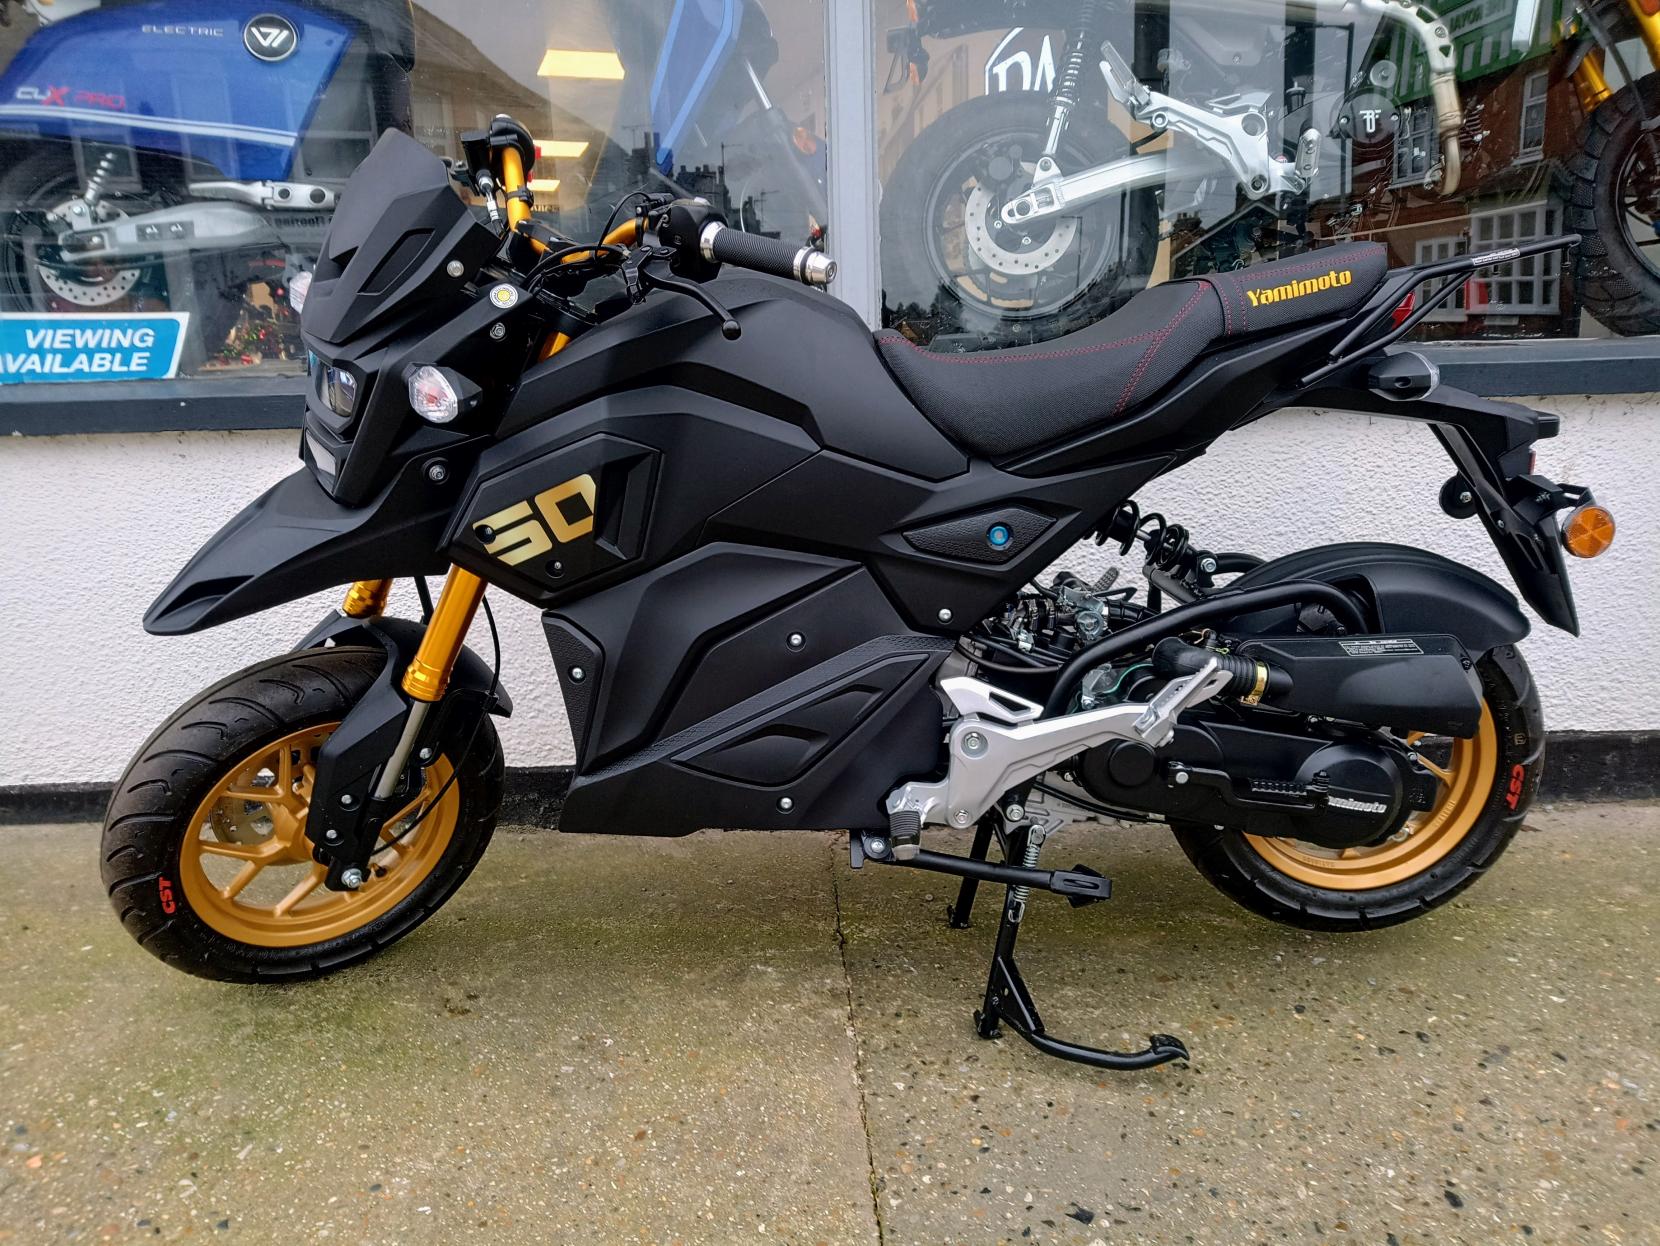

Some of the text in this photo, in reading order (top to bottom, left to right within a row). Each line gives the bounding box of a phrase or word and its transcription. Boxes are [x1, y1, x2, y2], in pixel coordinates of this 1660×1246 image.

[142, 24, 224, 37] ELECTRIC
[75, 90, 126, 111] PRO
[1246, 270, 1352, 307] Yamimoto
[25, 328, 155, 349] VIEWING
[0, 352, 150, 374] VAILABLE
[473, 474, 597, 567] 50
[1506, 765, 1525, 811] CST
[159, 876, 176, 914] CST
